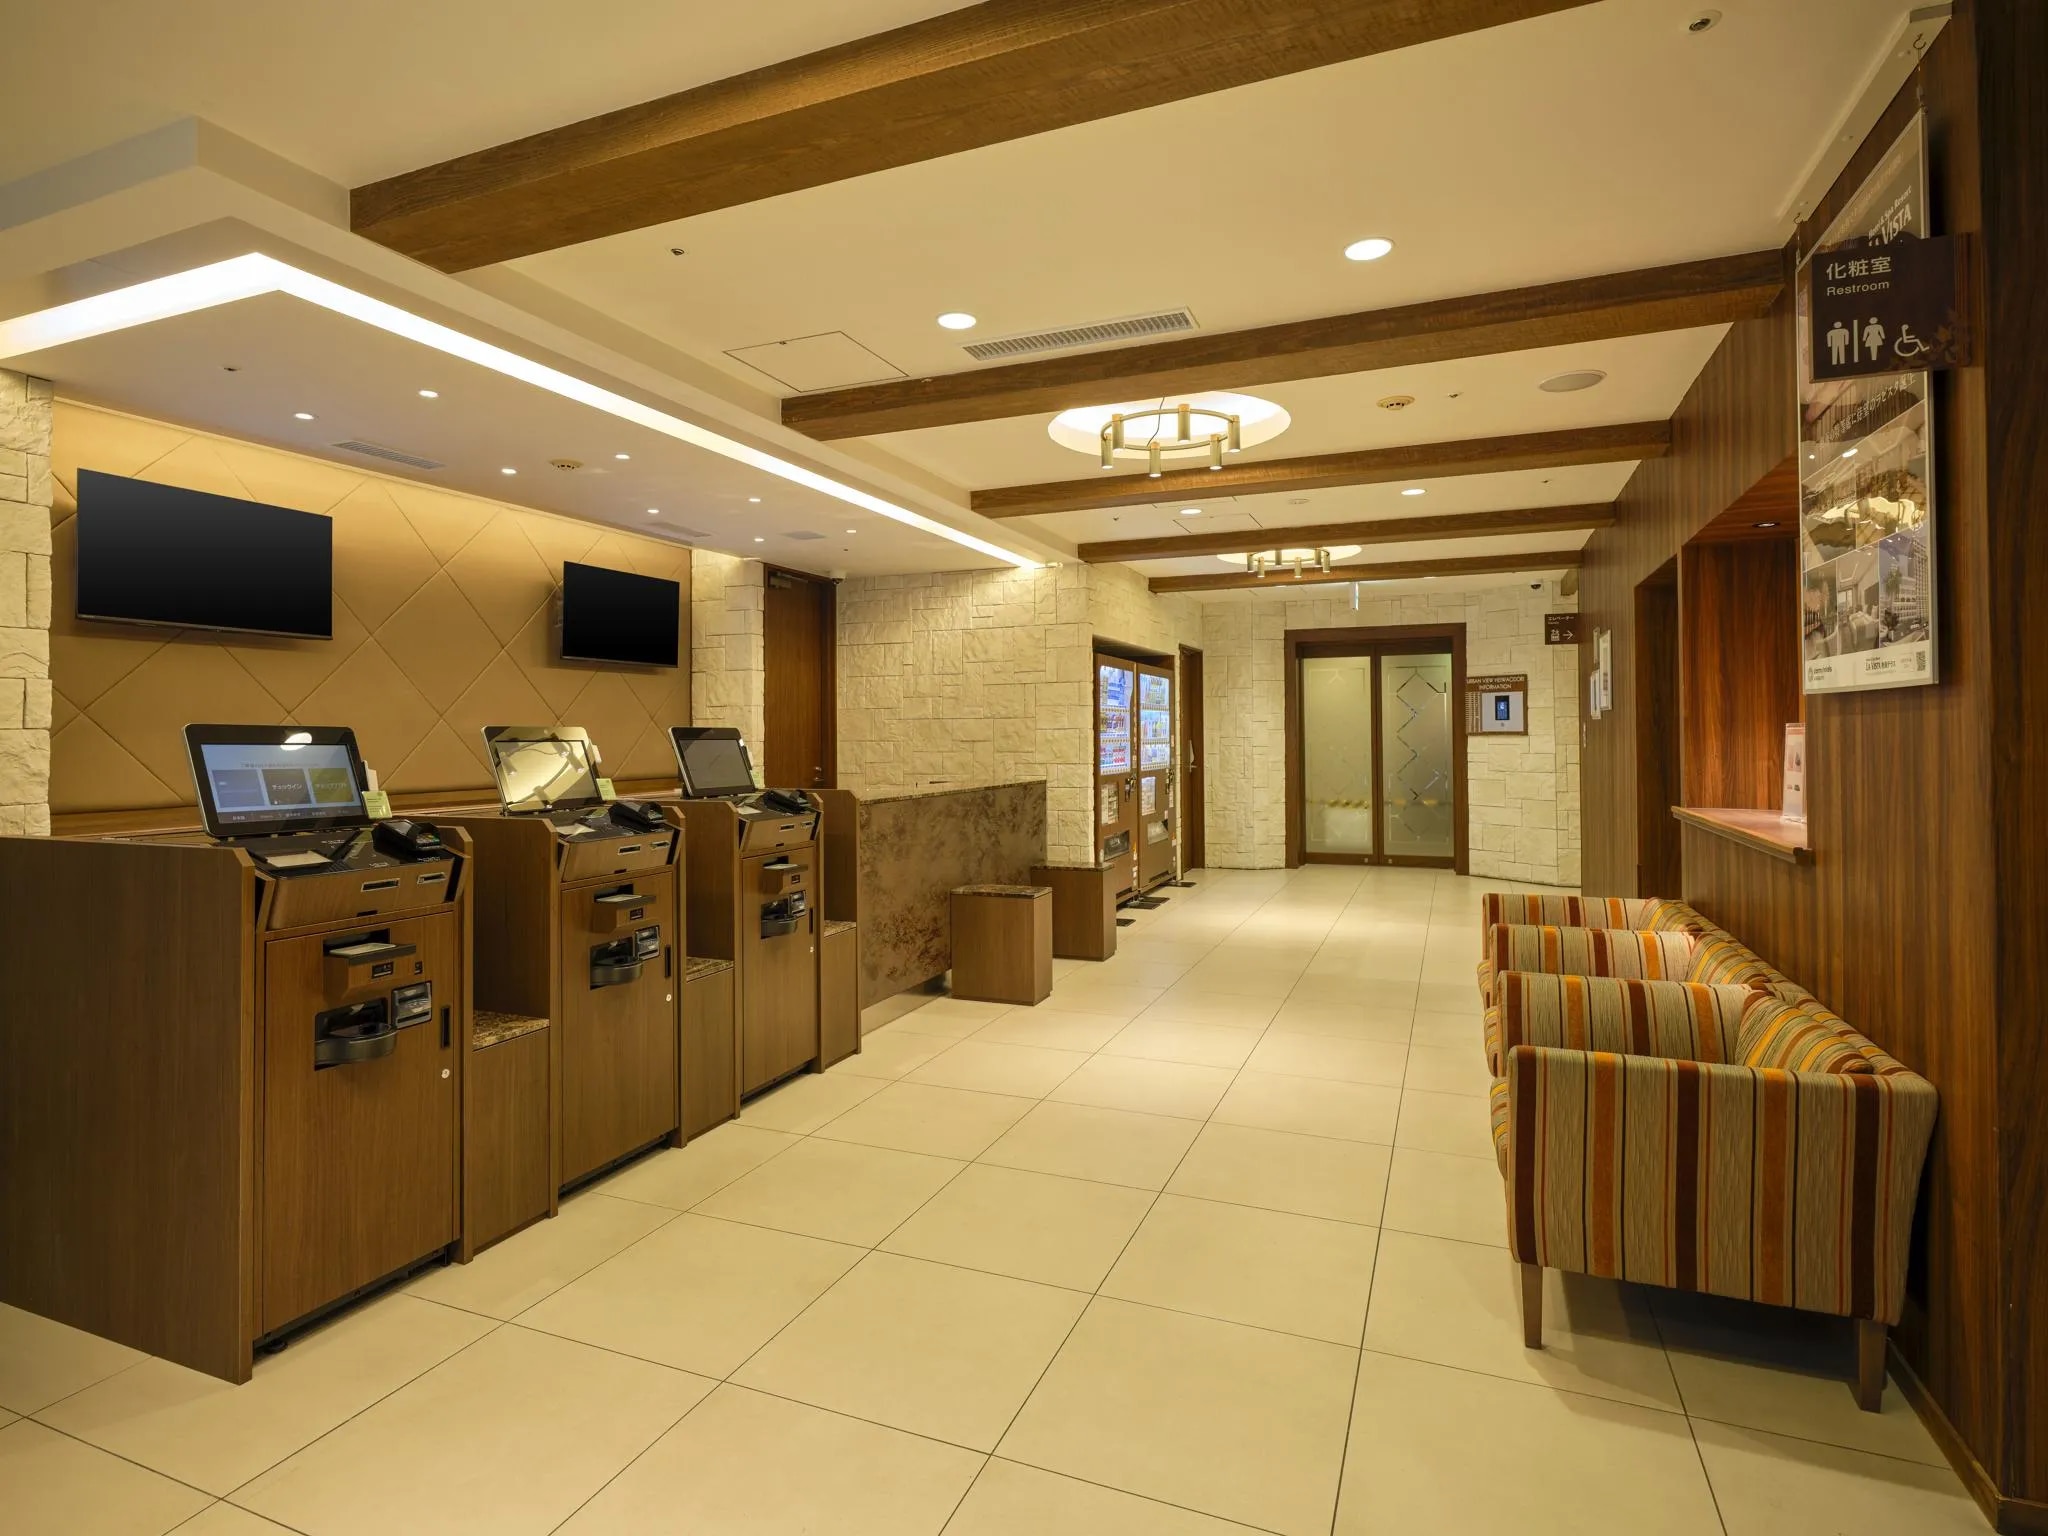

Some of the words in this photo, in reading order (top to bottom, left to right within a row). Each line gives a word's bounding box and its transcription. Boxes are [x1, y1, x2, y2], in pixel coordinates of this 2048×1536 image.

[1894, 184, 1912, 209] Resort
[1881, 203, 1912, 245] VISTA
[1826, 256, 1892, 281] 化粧室
[1827, 281, 1890, 297] Restroom
